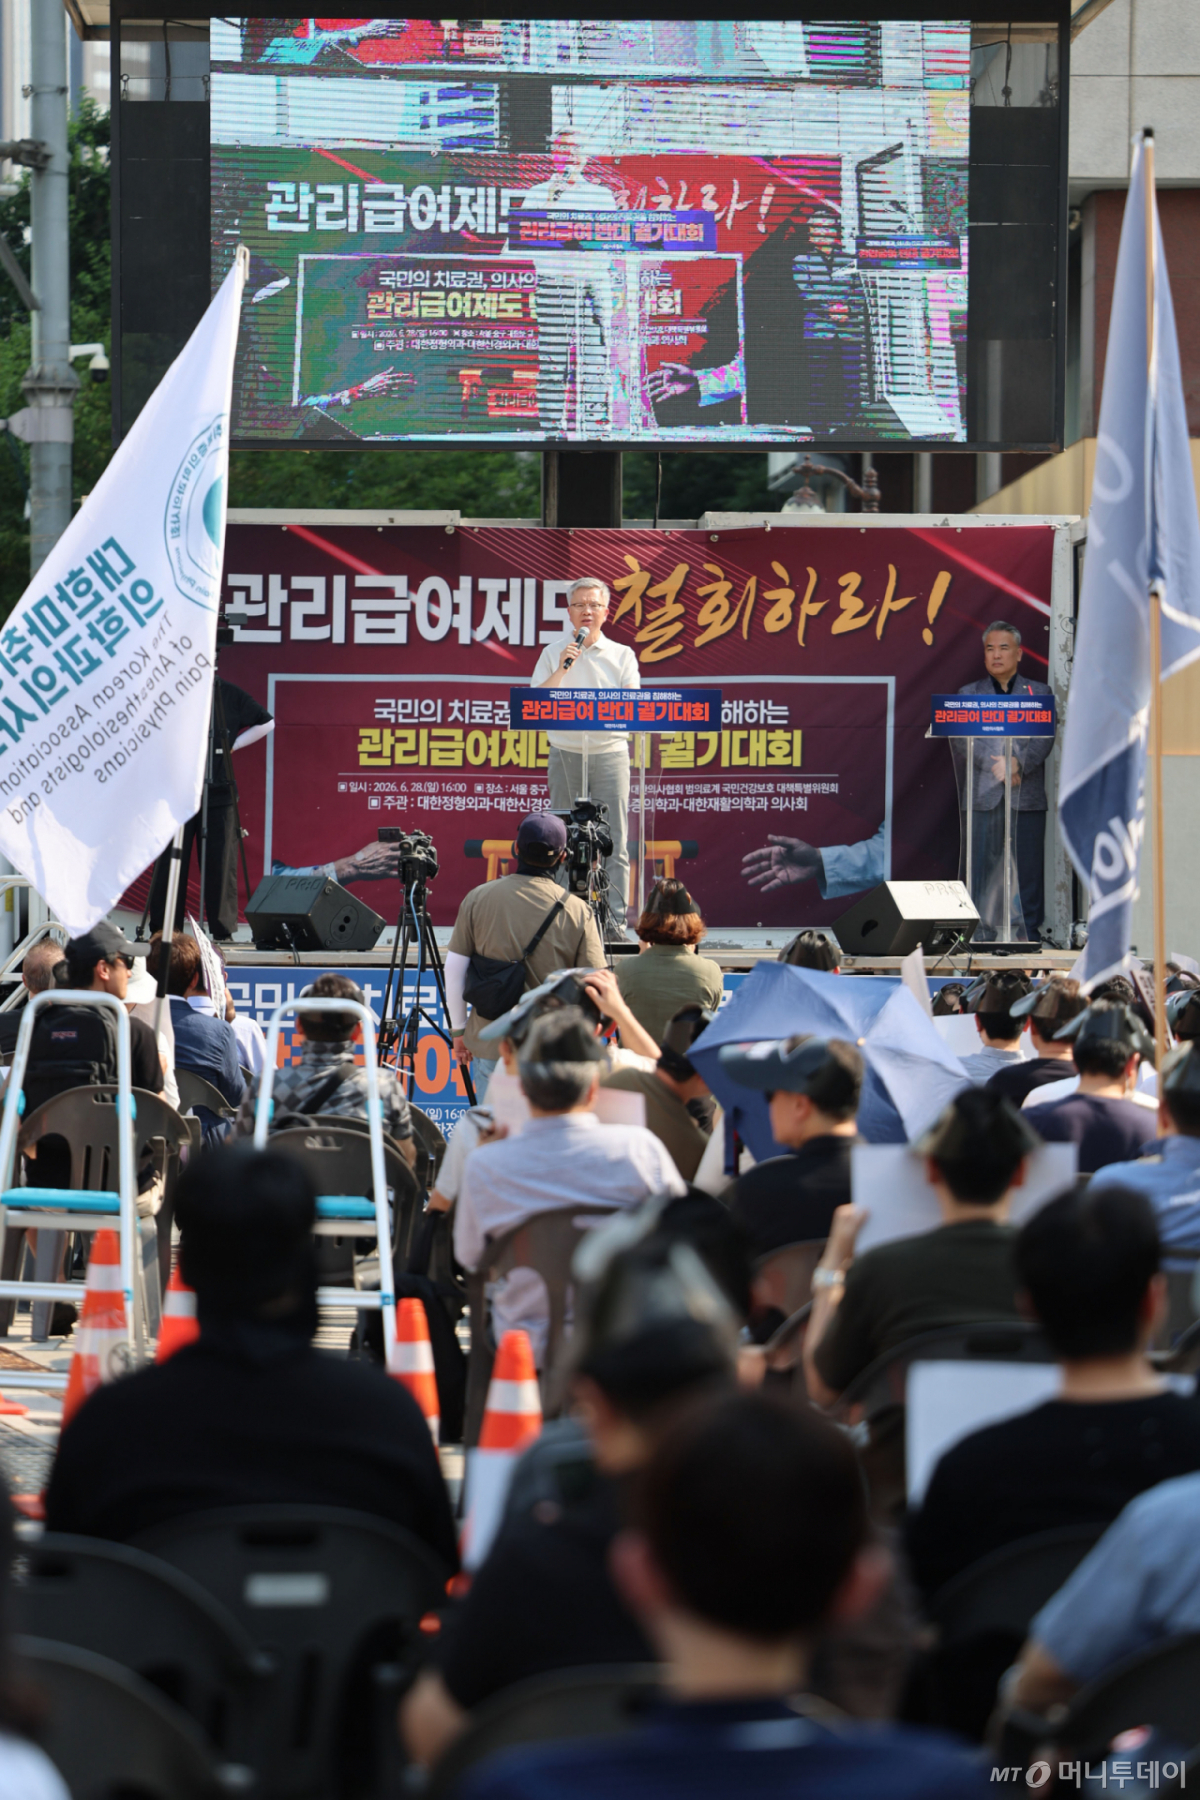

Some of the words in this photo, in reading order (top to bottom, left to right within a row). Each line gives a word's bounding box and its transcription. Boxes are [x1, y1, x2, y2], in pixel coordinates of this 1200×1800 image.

[379, 270, 430, 288] 국민의
[433, 271, 487, 290] 치료권,
[367, 291, 523, 319] 관리급여제도
[612, 554, 952, 664] 철회하라!
[549, 690, 572, 700] 국민의
[598, 691, 620, 700] 의사의
[621, 691, 651, 700] 진료권을
[652, 692, 682, 701] 침해하는
[373, 698, 442, 724] 국민의
[521, 700, 594, 720] 관리급여
[597, 701, 634, 721] 반대
[637, 702, 710, 722] 궐기대회
[934, 710, 980, 723] 관리급여
[981, 710, 1005, 723] 반대
[1006, 710, 1052, 723] 궐기대회
[658, 729, 802, 769] 궐기대회
[349, 782, 367, 793] 일시
[373, 782, 399, 793] 2026.
[441, 782, 467, 793] 16:00
[485, 783, 504, 795] 장소
[510, 784, 528, 795] 서울
[529, 784, 548, 796] 중구
[685, 783, 720, 795] 범의료계
[721, 783, 775, 795] 국민건강보호
[777, 782, 839, 795] 대책특별위원회
[383, 795, 408, 810] 주관
[628, 796, 768, 813] 증의학과·대한재활의학과
[770, 796, 808, 812] 의사회
